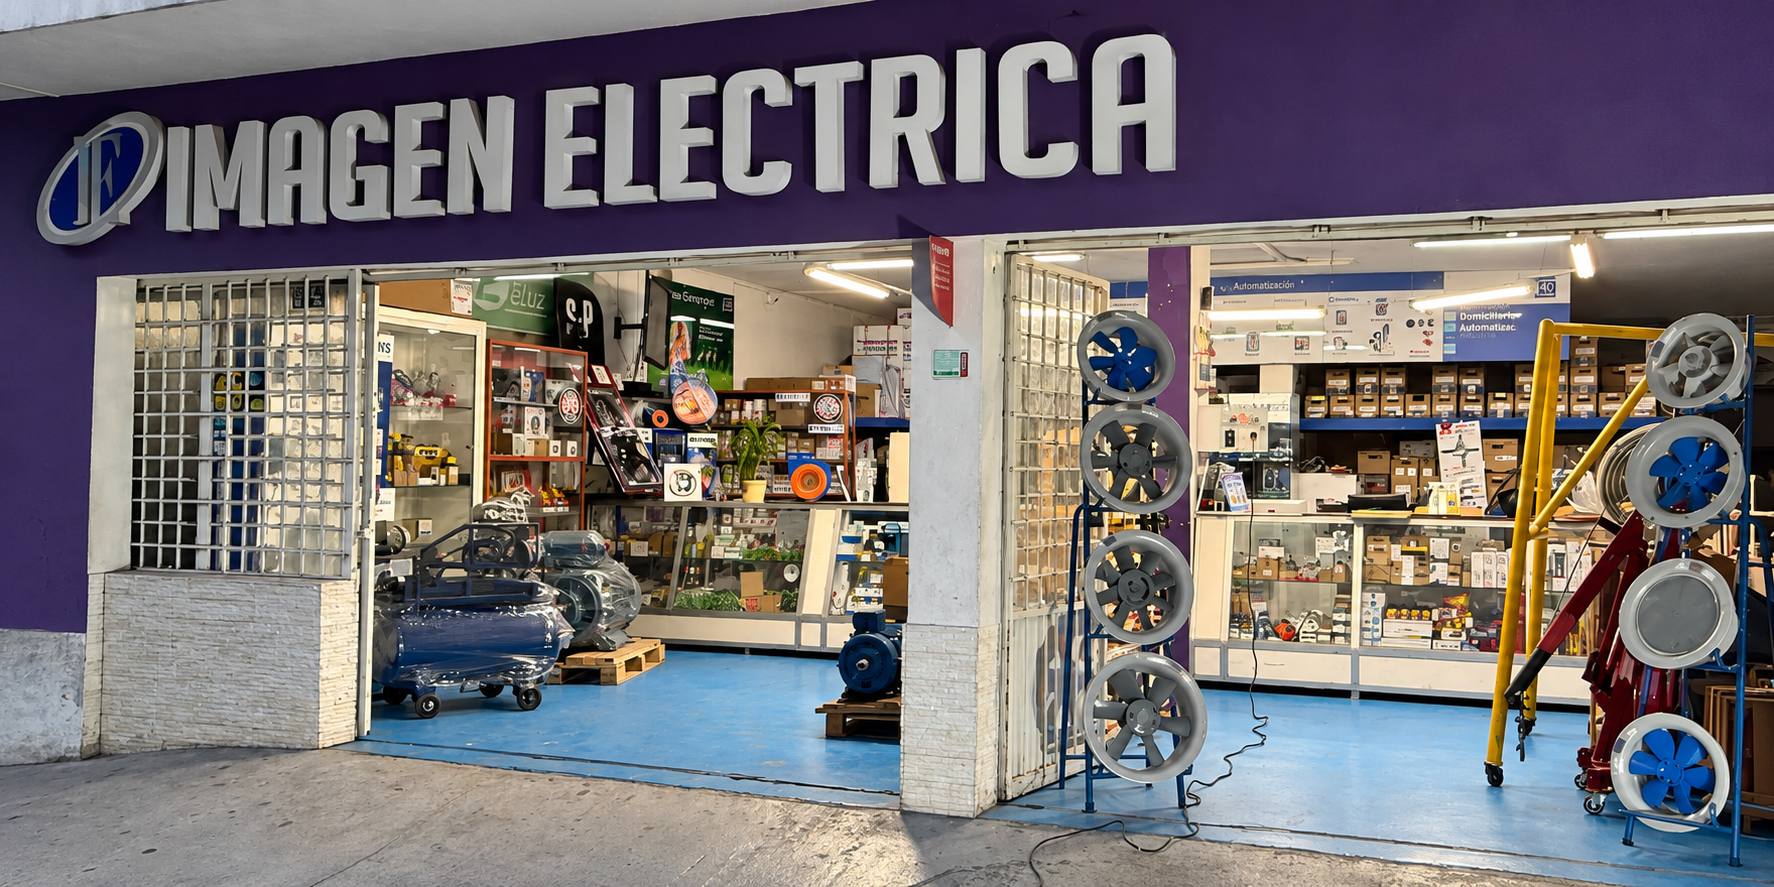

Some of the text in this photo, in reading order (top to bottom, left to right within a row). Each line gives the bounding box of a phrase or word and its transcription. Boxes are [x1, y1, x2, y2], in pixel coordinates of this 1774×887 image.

[166, 95, 515, 233] IMAGEN
[544, 33, 1177, 209] ELECTRICA
[1232, 280, 1296, 291] Automatización
